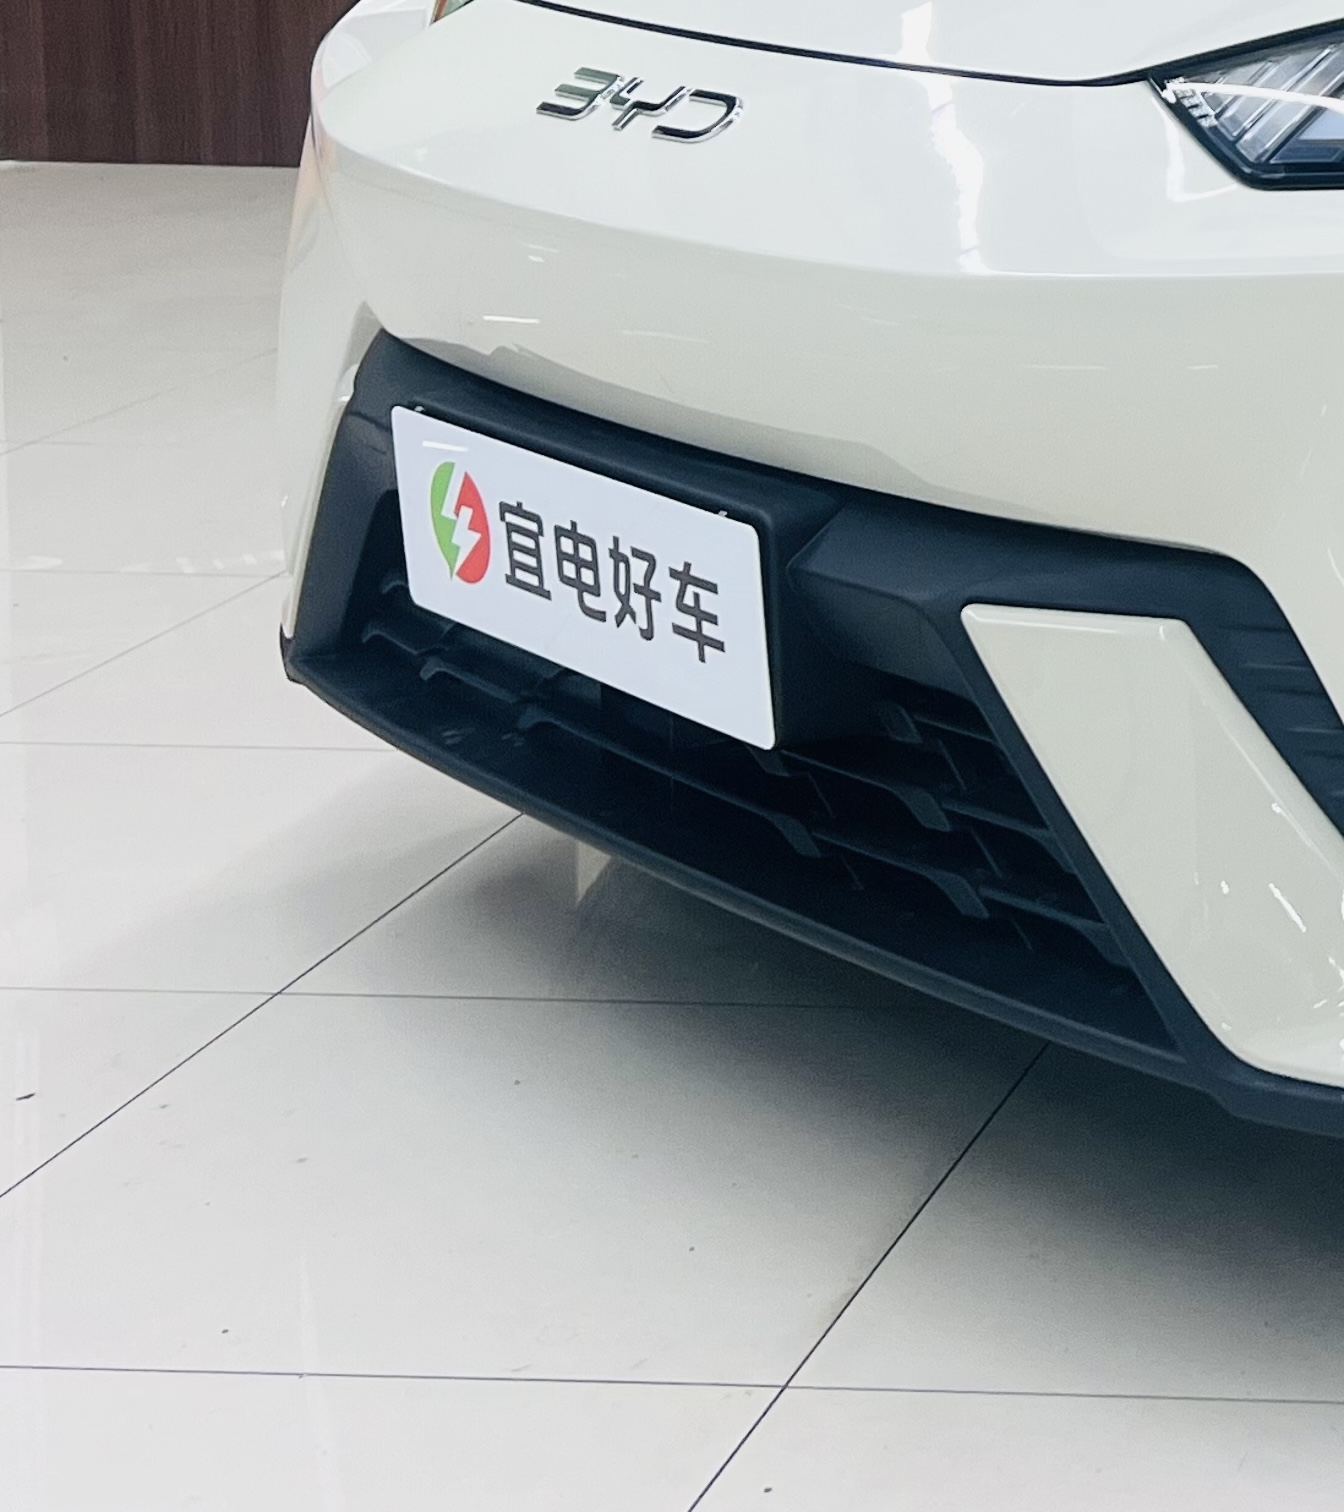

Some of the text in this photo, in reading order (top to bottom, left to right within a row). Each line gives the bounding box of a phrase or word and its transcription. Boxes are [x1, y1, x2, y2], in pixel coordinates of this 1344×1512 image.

[536, 66, 744, 144] BYD
[498, 500, 726, 664] 宜电好车
